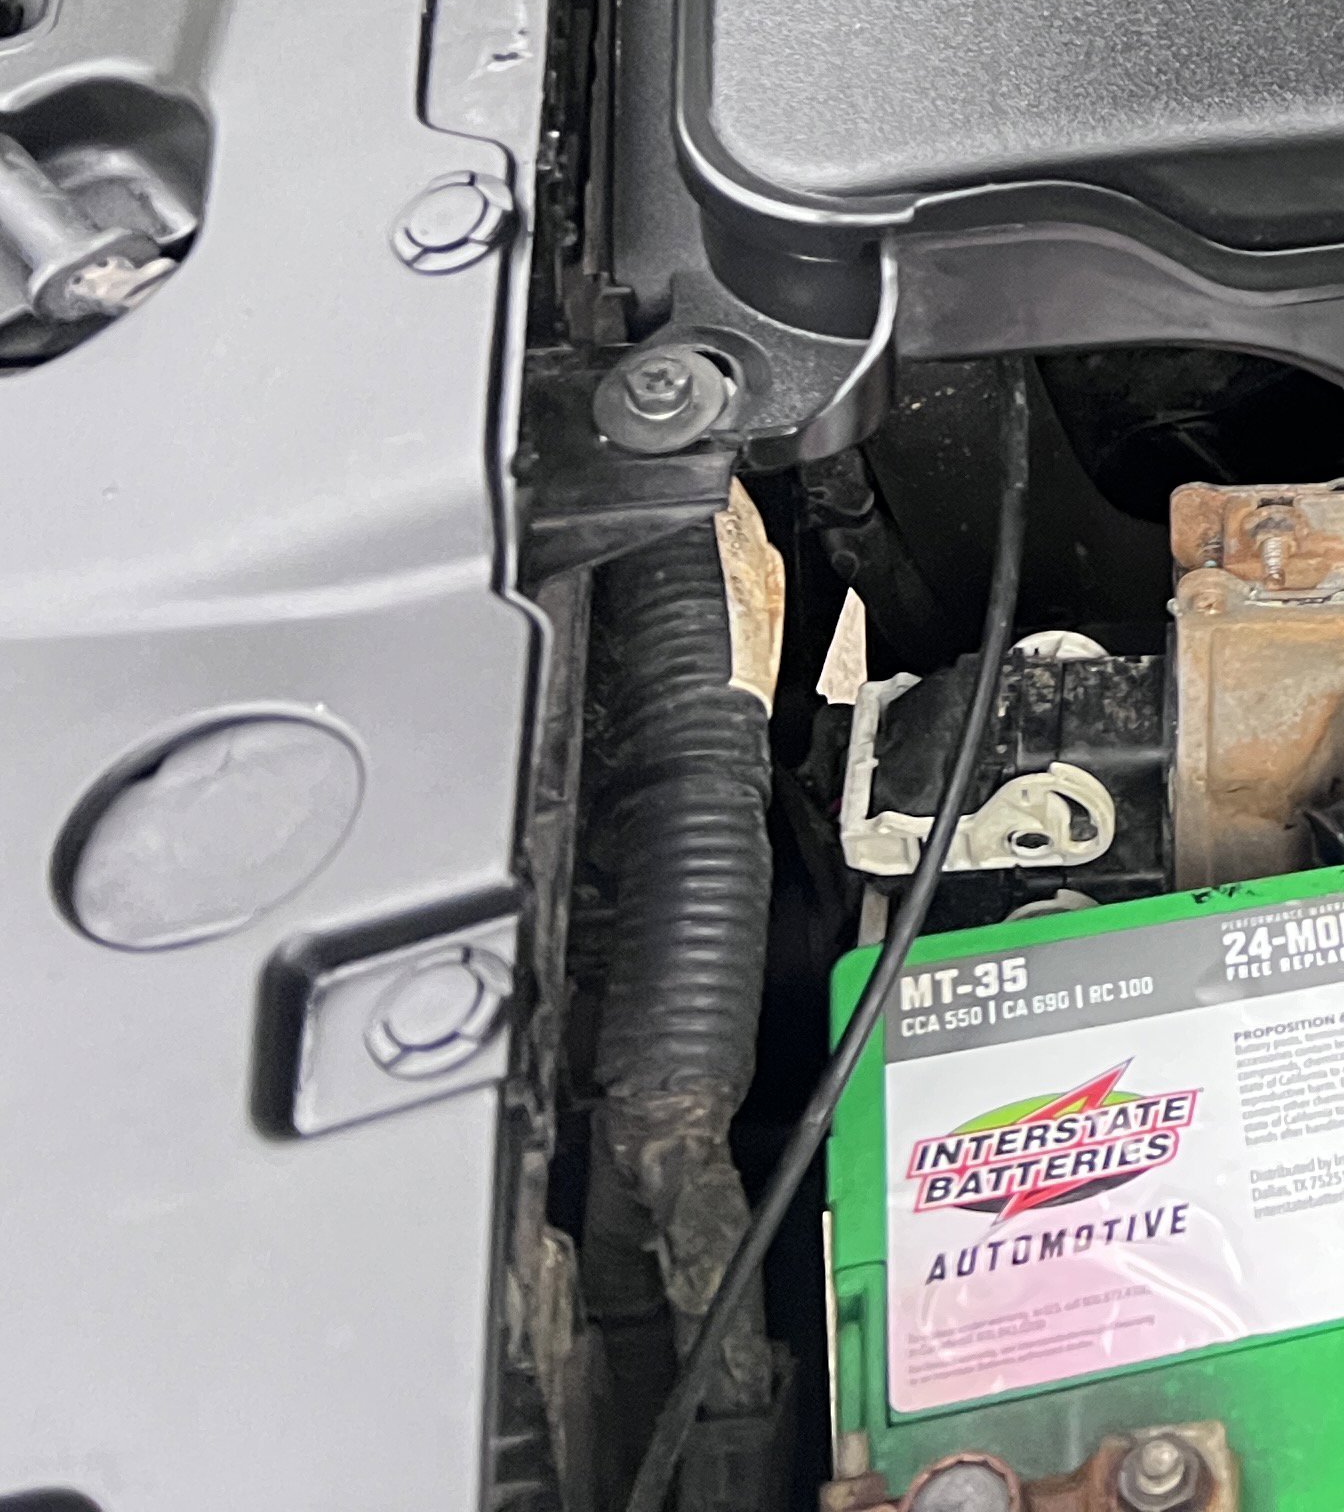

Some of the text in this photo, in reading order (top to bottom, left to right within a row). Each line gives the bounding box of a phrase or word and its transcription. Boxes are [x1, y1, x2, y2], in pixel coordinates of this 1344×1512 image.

[900, 957, 1028, 1011] MT-35
[1226, 961, 1272, 981] FREE
[901, 976, 1154, 1037] CCA 550 CA 690 RC 100
[1233, 1013, 1335, 1042] PROPOSITION
[915, 1094, 1190, 1172] INTERSTATE
[924, 1133, 1171, 1204] BATTERIES
[924, 1203, 1190, 1286] AUTOMOTIVE
